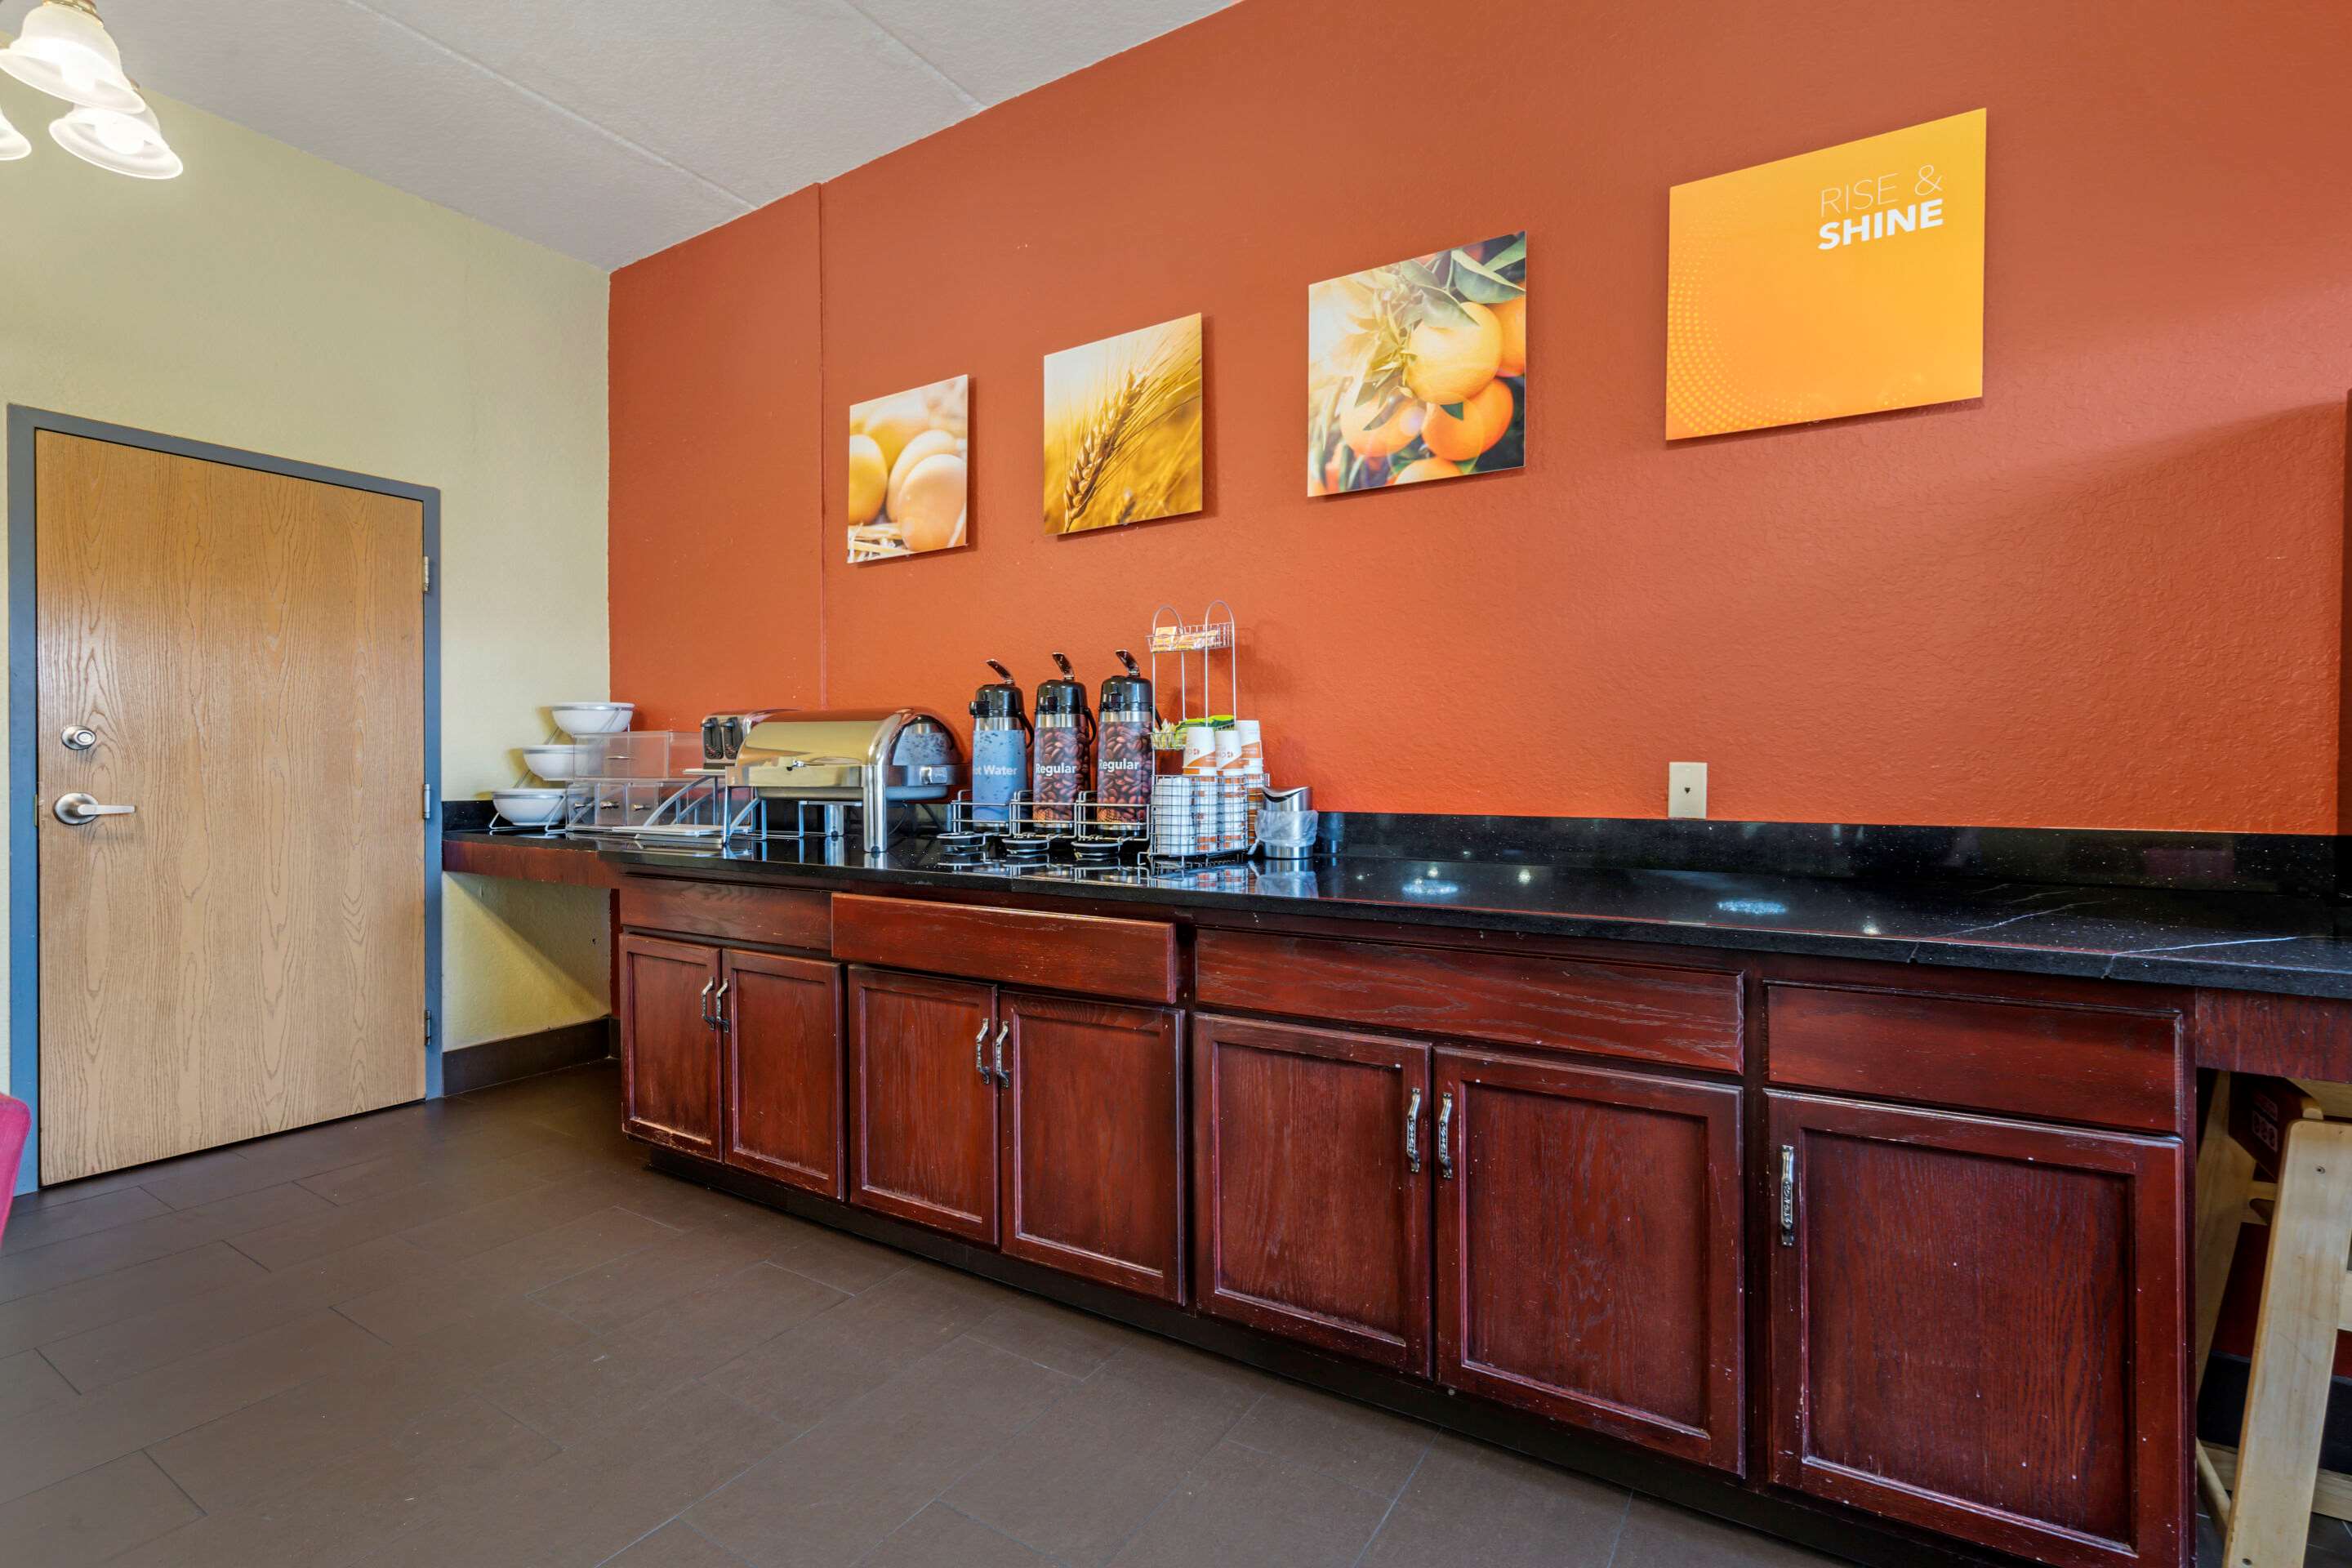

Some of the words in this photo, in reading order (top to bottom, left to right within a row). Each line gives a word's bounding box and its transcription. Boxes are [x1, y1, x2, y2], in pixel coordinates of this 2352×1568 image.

[1820, 172, 1900, 218] RISE
[1914, 164, 1944, 196] &
[1817, 198, 1944, 251] SHINE
[983, 764, 1018, 776] Water
[1036, 763, 1077, 777] Regular
[1098, 758, 1140, 772] Regular
